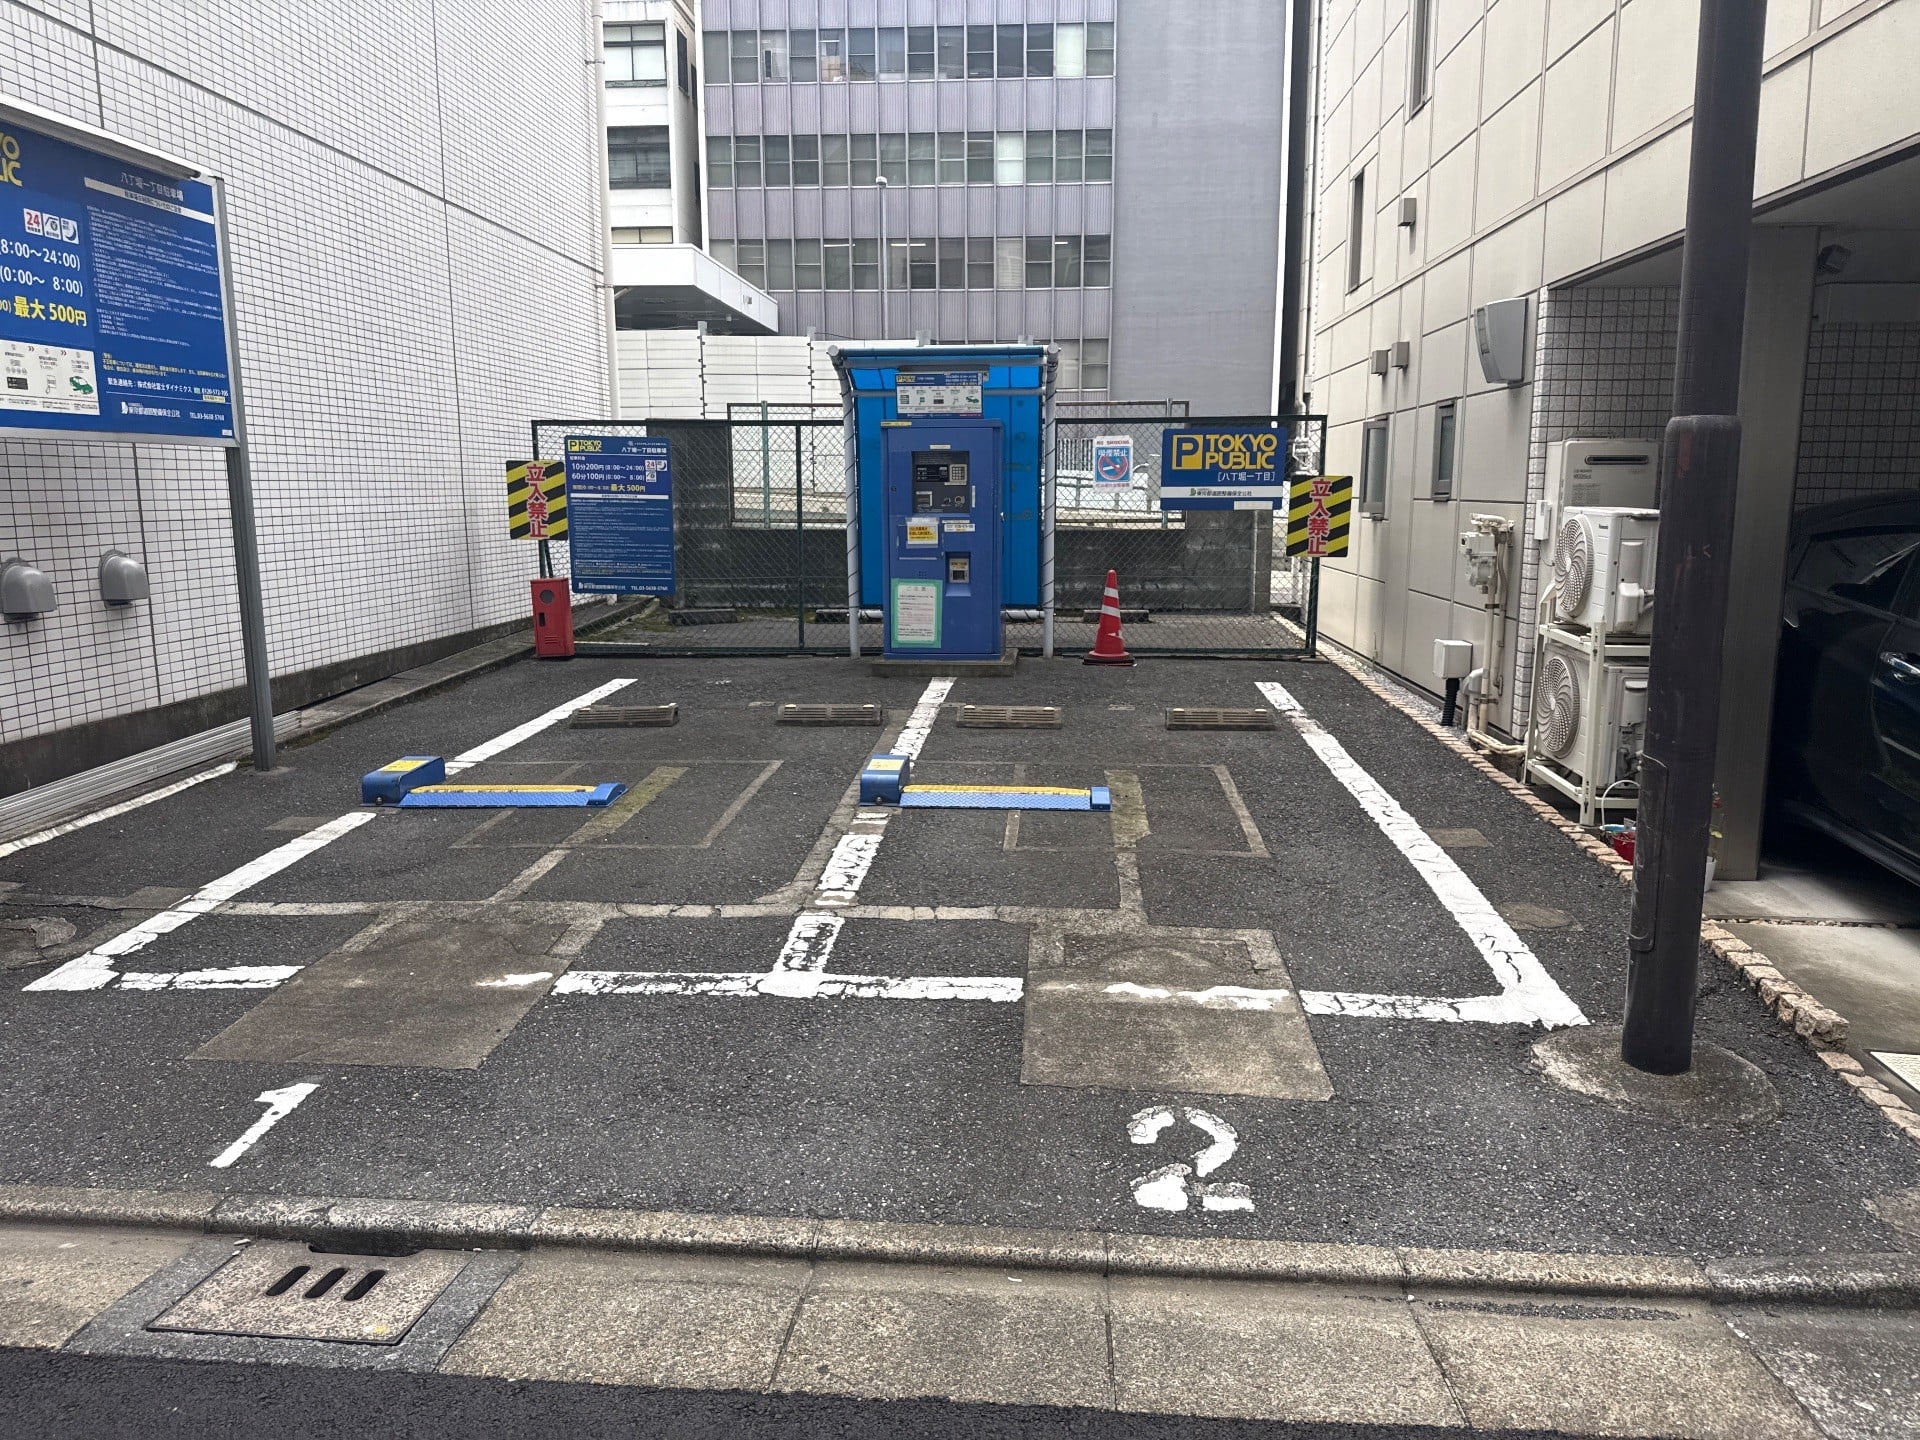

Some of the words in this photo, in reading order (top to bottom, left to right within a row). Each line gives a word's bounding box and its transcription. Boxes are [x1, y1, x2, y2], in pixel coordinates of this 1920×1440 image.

[26, 211, 40, 227] 24
[14, 295, 46, 320] 最大
[49, 302, 87, 327] 500円
[1205, 434, 1277, 452] TOKYO
[571, 463, 604, 471] 10分200円
[1205, 452, 1275, 470] PUBLIC
[571, 472, 605, 480] 60分100円
[524, 464, 550, 538] 立入禁止
[1307, 479, 1332, 556] 立入禁止
[207, 1082, 321, 1168] 1
[1126, 1105, 1256, 1212] 2
